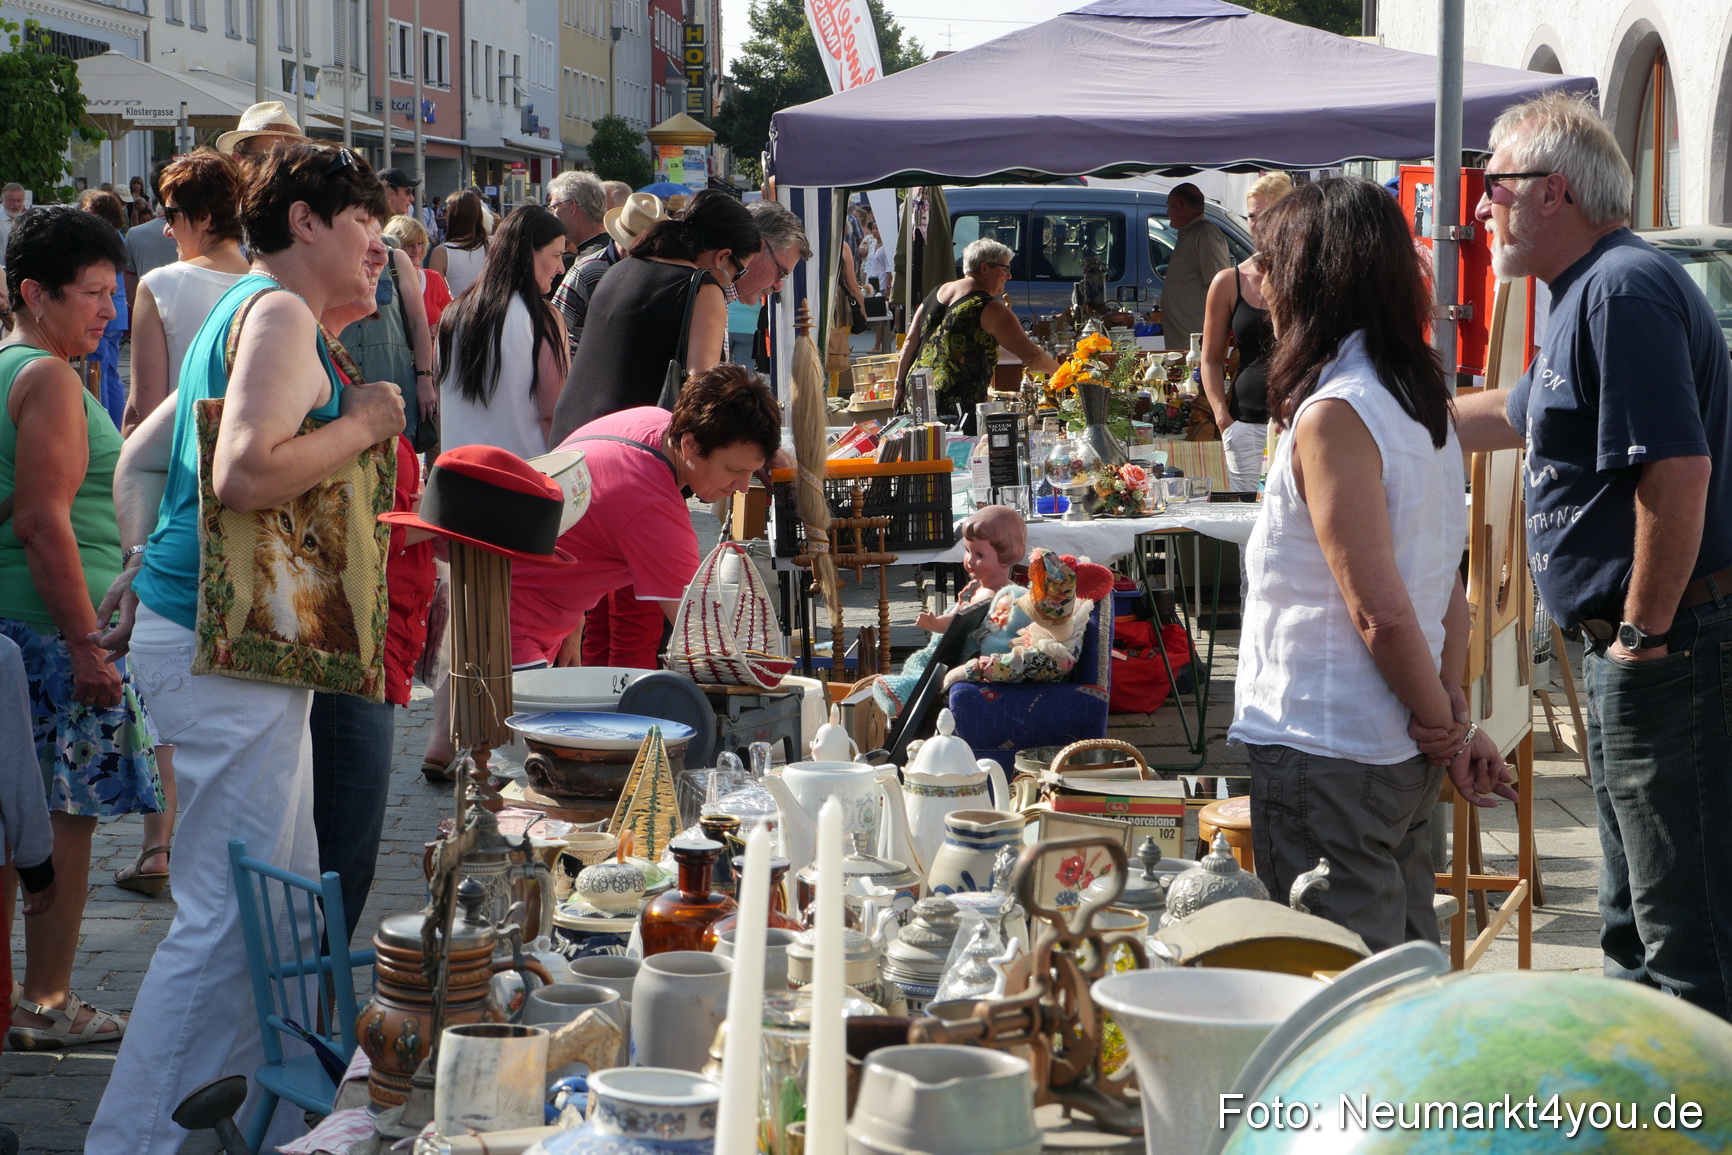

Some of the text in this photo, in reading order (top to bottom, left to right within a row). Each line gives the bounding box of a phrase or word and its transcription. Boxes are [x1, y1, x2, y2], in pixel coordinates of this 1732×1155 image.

[685, 26, 704, 108] HOTE
[375, 99, 411, 111] stor.
[125, 107, 175, 118] Klostergasse
[1525, 505, 1583, 535] OTHING
[1158, 828, 1176, 840] 102
